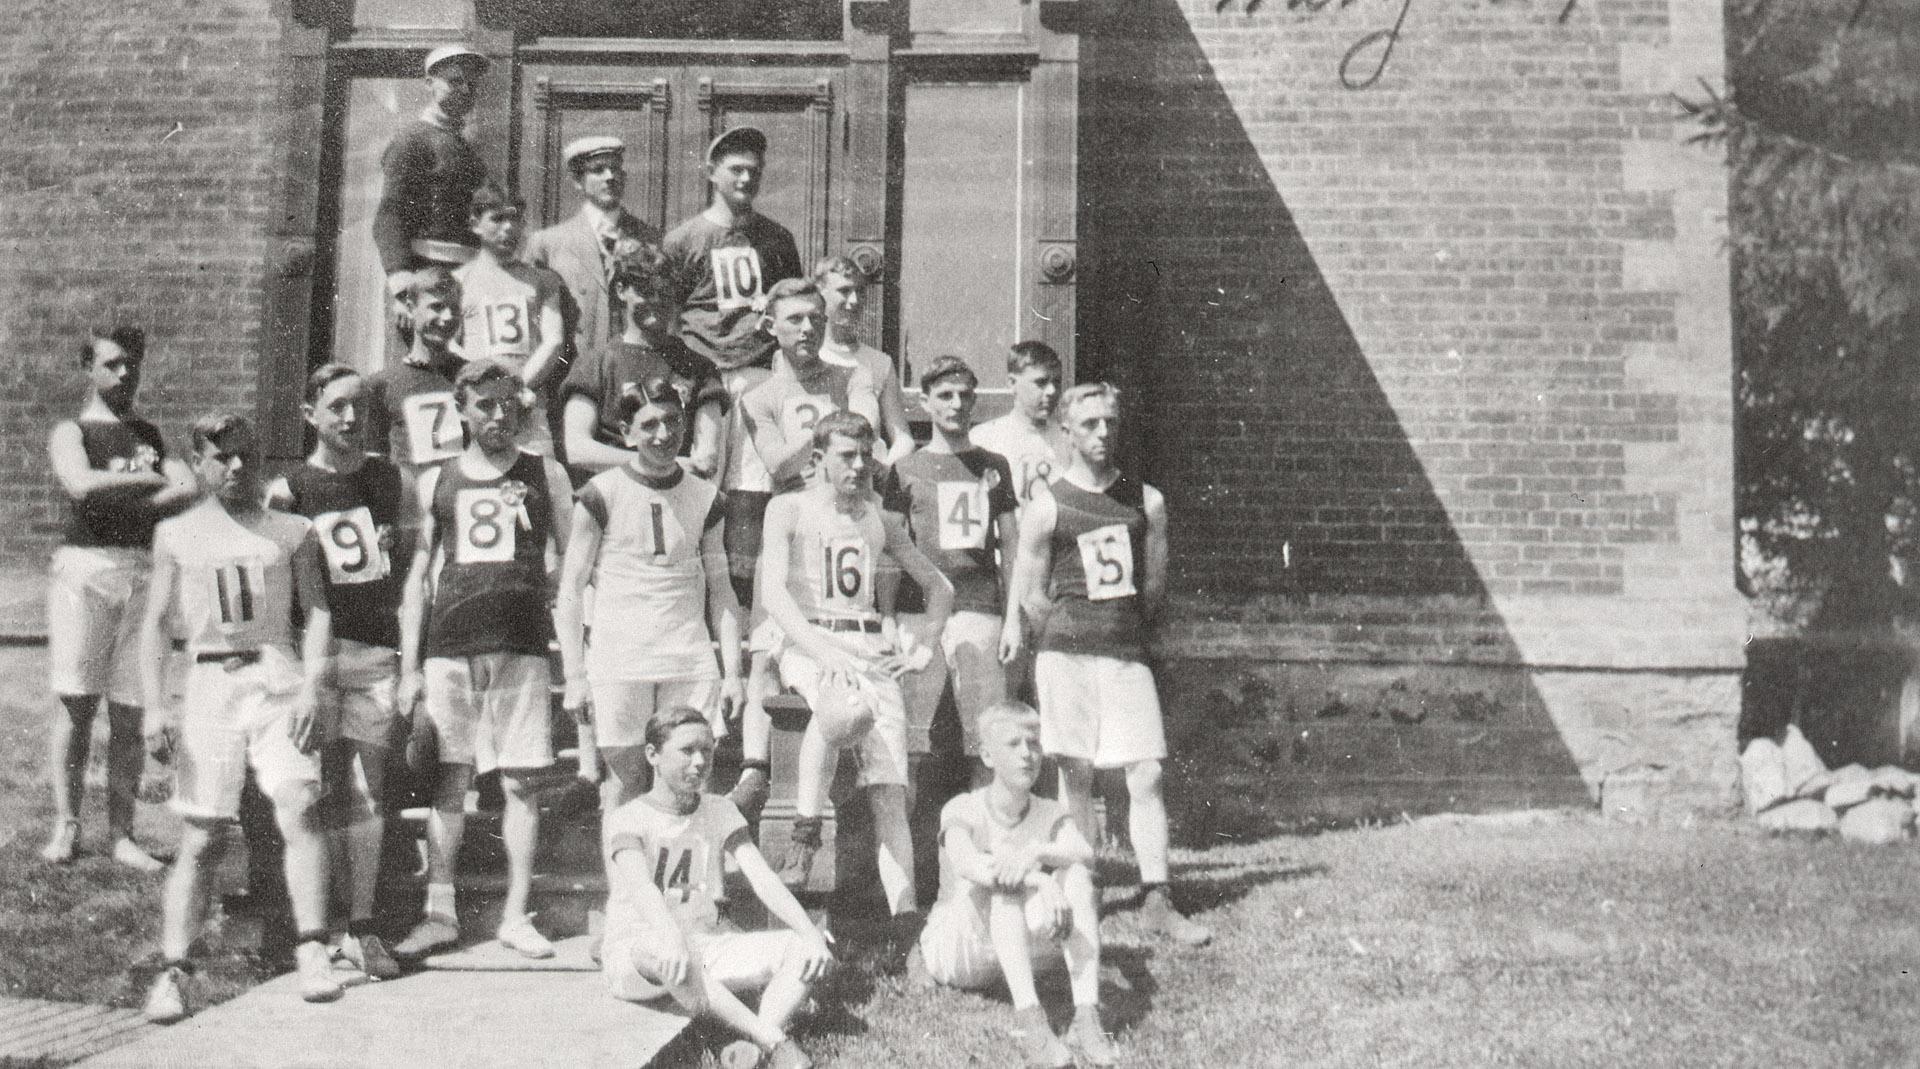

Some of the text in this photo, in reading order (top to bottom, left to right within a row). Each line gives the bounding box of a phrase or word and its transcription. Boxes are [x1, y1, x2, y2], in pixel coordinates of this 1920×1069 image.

[720, 254, 757, 299] 10
[485, 304, 524, 343] 13
[418, 404, 446, 448] 7
[469, 499, 503, 549] 8
[650, 502, 668, 555] 1
[948, 491, 981, 537] 4
[332, 520, 368, 573] 9
[824, 546, 860, 598] 16
[1097, 534, 1124, 586] 5
[216, 566, 254, 624] 11
[655, 847, 691, 903] 14
